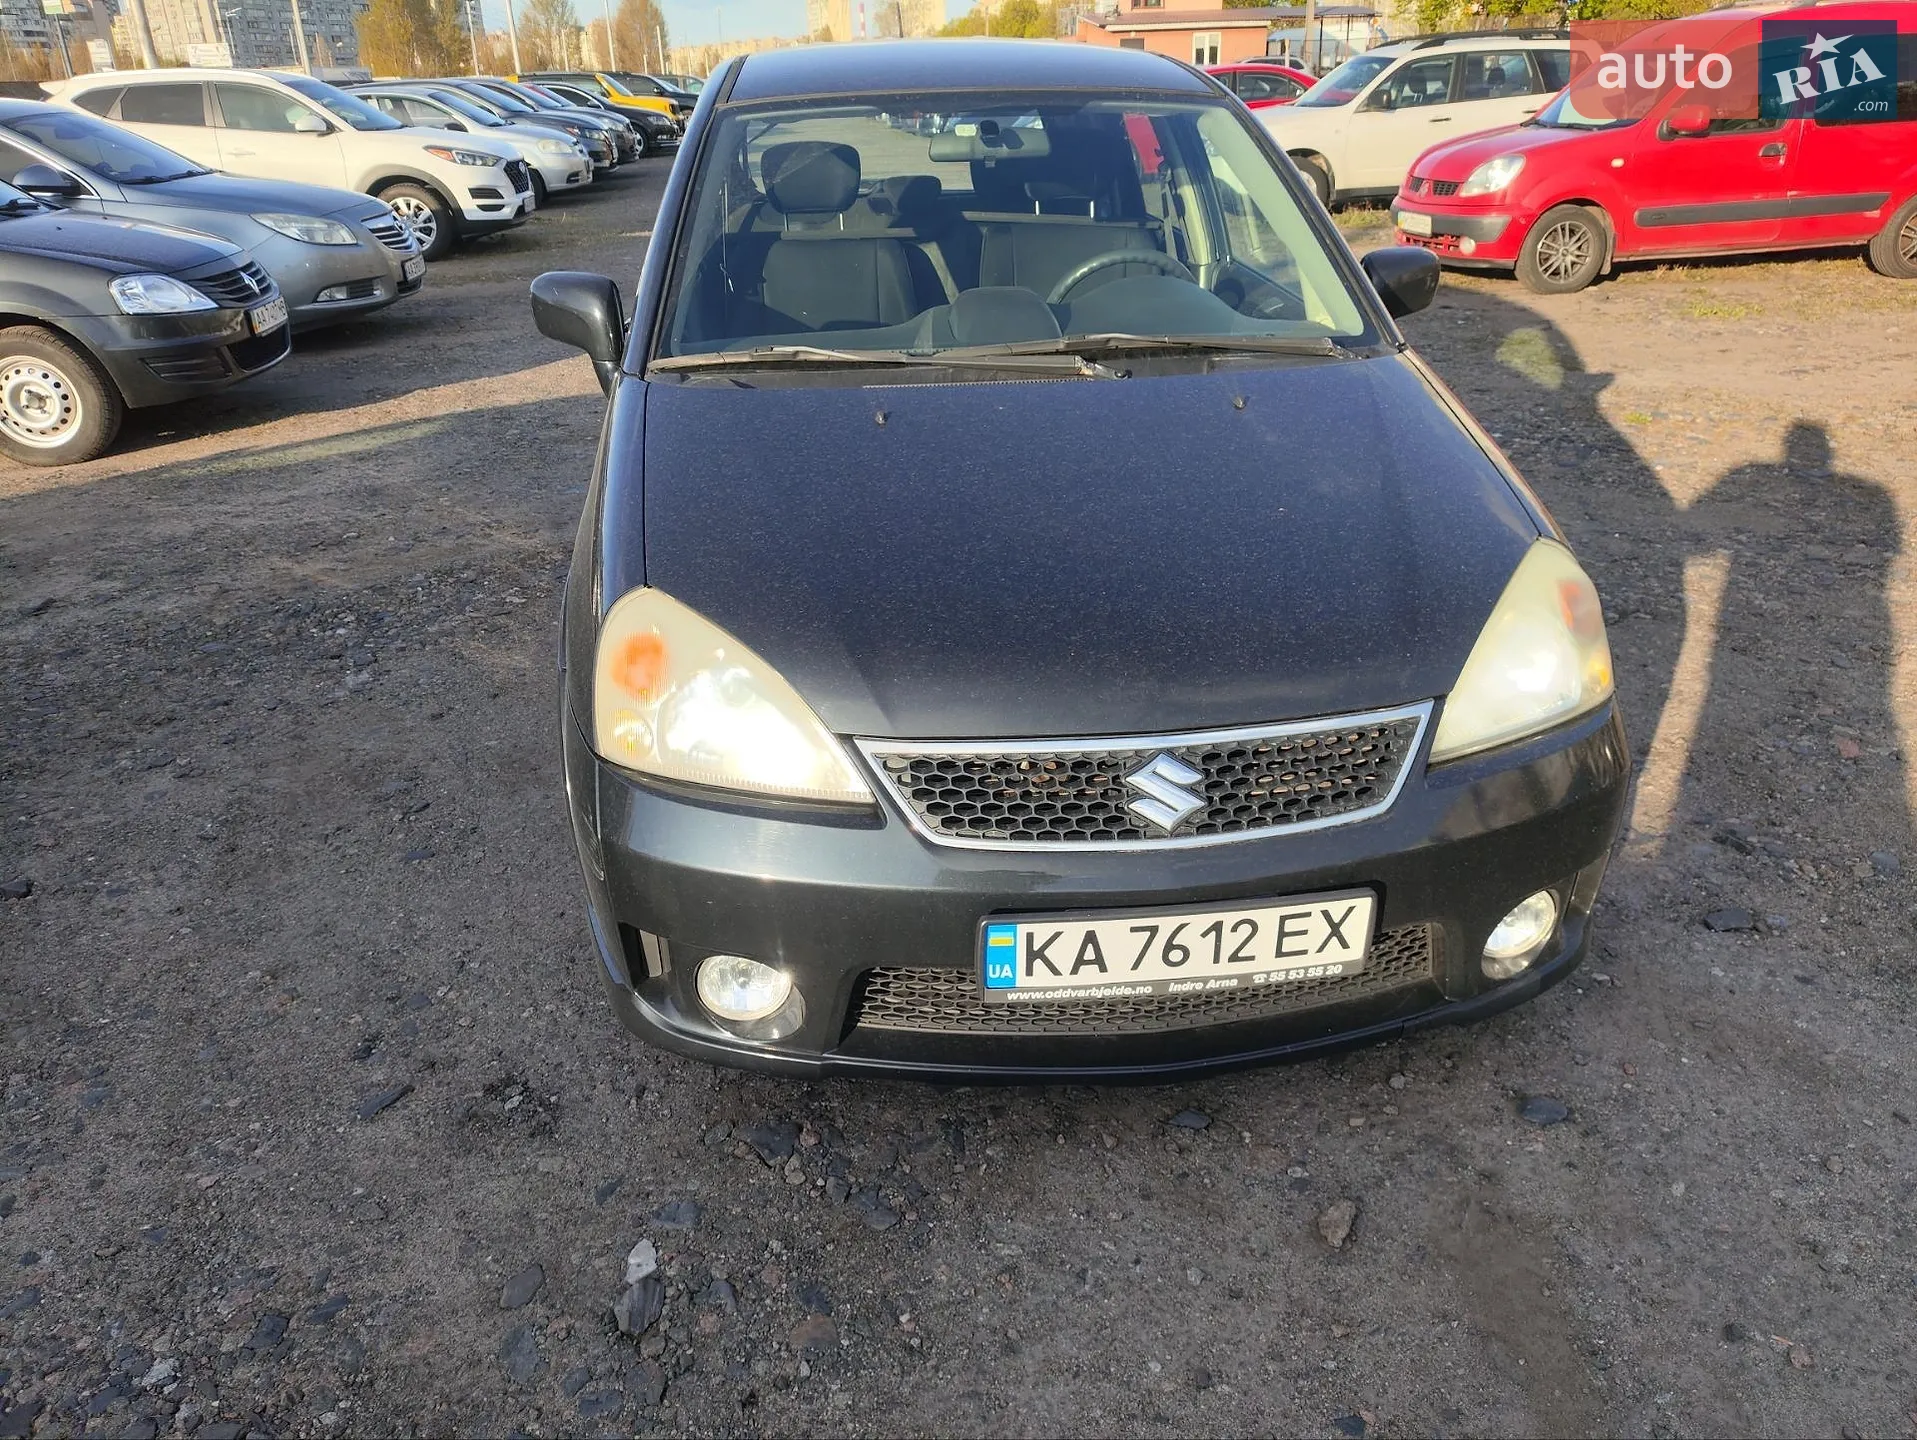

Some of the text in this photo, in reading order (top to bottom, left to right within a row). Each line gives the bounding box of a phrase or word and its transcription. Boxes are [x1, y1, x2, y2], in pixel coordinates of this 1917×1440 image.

[1024, 905, 1358, 977] KA 7612 EX
[988, 963, 1013, 980] UA
[1205, 978, 1239, 989] Arna
[1325, 964, 1343, 975] 20
